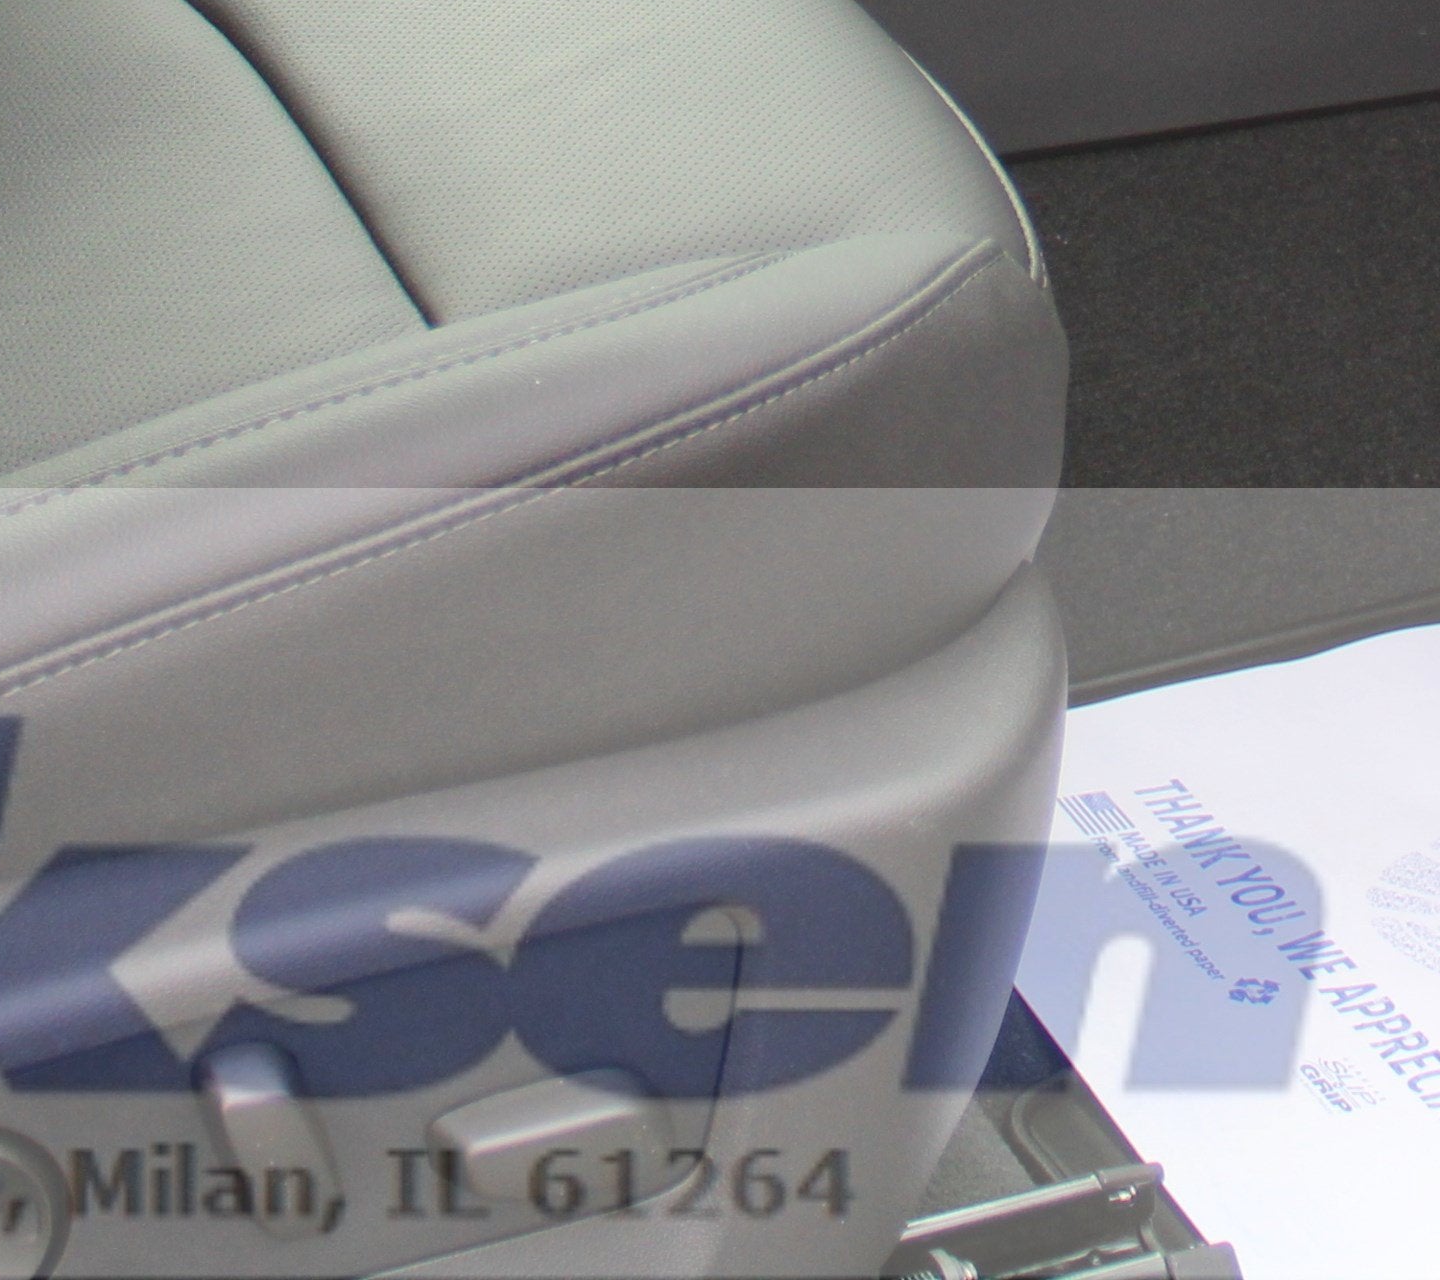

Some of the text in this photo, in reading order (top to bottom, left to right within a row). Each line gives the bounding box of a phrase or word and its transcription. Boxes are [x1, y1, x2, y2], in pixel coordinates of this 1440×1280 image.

[1090, 836, 1121, 864] From
[1187, 947, 1225, 981] paper
[1117, 831, 1208, 917] MADE IN USA
[1134, 778, 1252, 870] THANK
[1215, 865, 1307, 936] YOU,
[1277, 930, 1357, 981] WE
[1300, 1064, 1353, 1112] GRIP
